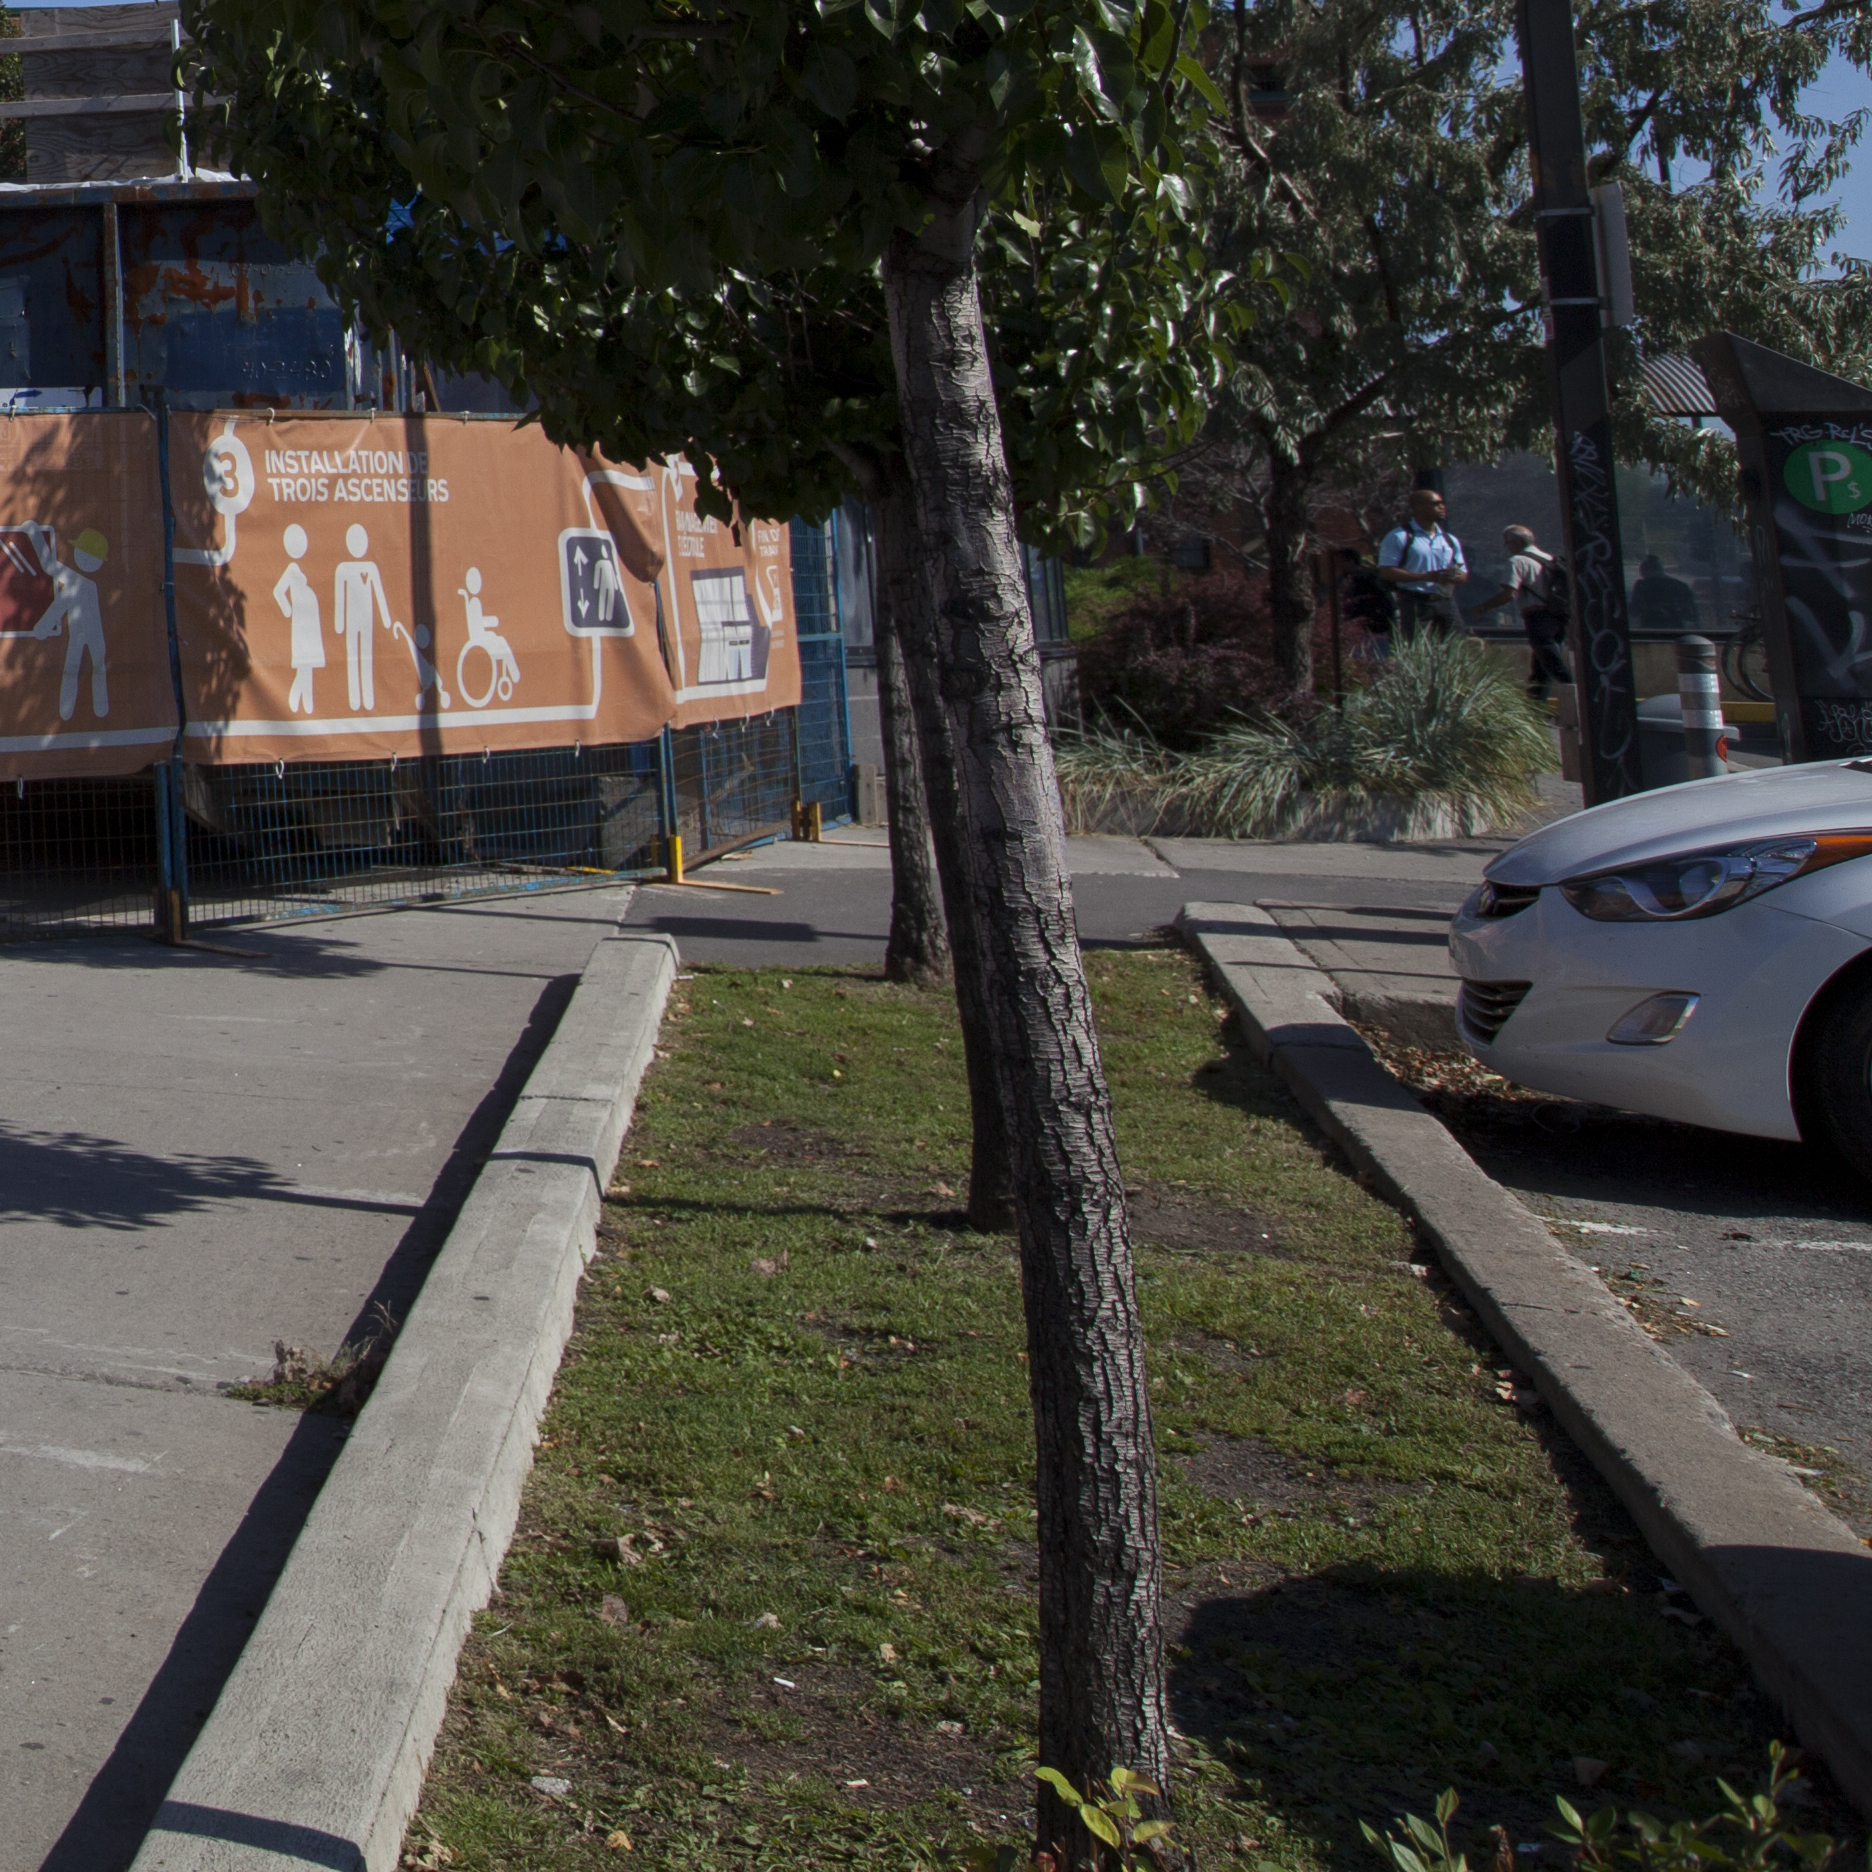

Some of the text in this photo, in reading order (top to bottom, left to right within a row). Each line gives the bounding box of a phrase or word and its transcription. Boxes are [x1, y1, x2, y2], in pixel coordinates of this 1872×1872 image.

[218, 451, 240, 499] 3
[265, 449, 429, 475] INSTALLATION DE
[1808, 451, 1851, 501] P
[267, 478, 449, 503] TROIS ASCENSEURS
